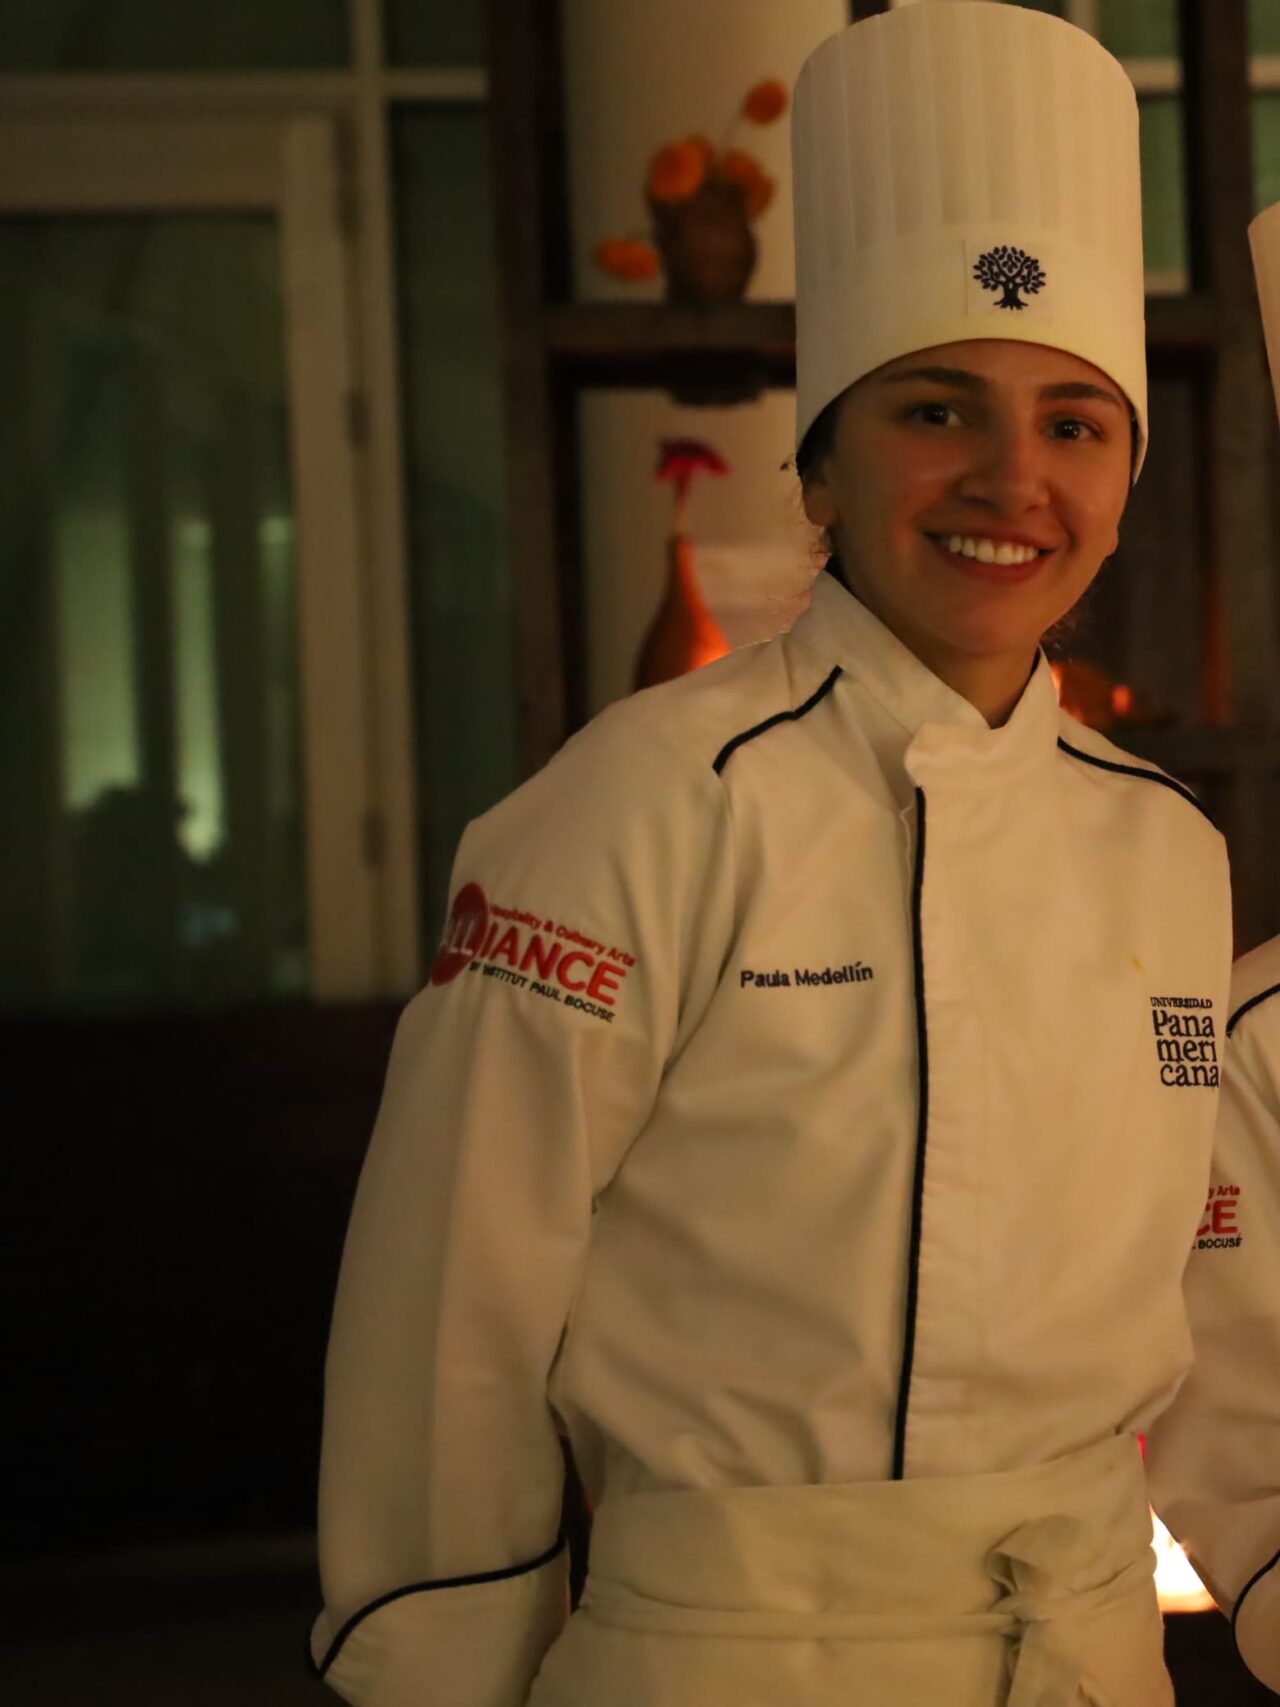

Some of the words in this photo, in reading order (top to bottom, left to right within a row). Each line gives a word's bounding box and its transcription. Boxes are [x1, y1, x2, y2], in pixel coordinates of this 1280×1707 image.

[607, 947, 636, 967] Arts
[740, 970, 791, 988] Paula
[795, 961, 873, 986] Medellín
[563, 995, 616, 1023] BOCUSE
[1150, 996, 1213, 1009] UNIVERSIDAD
[1152, 1009, 1215, 1037] Pana
[1160, 1063, 1219, 1088] cana
